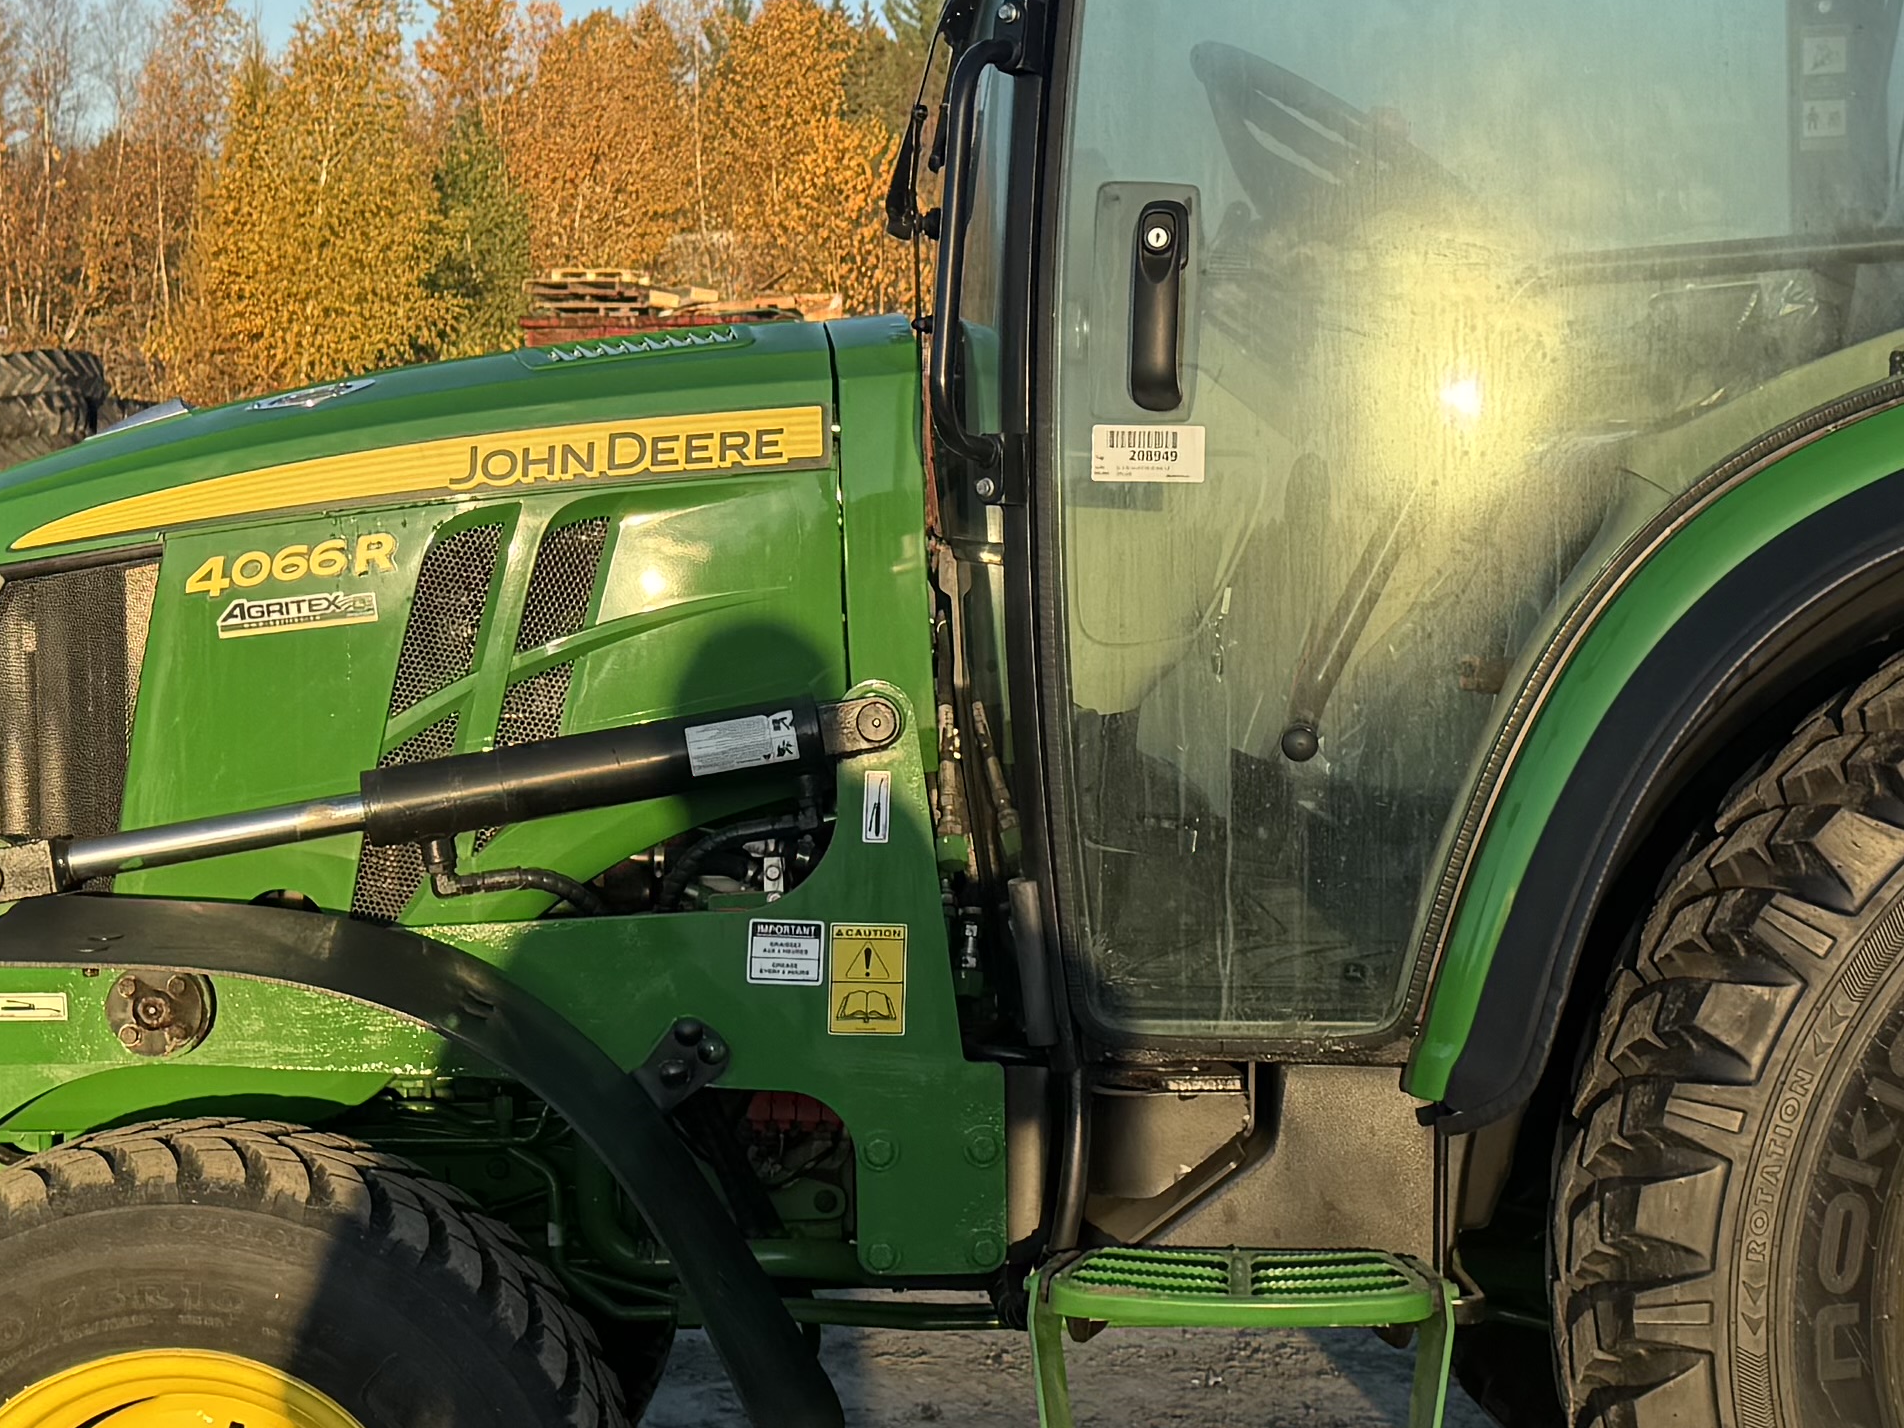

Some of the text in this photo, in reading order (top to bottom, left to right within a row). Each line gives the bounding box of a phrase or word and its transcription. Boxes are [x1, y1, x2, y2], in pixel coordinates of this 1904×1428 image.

[448, 427, 785, 485] JOHN DEERE
[1128, 449, 1178, 462] 208949
[220, 594, 344, 623] AGRITEX
[756, 923, 816, 936] IMPORTANT
[845, 928, 901, 938] CAUTION
[1743, 1068, 1814, 1264] ROTATION
